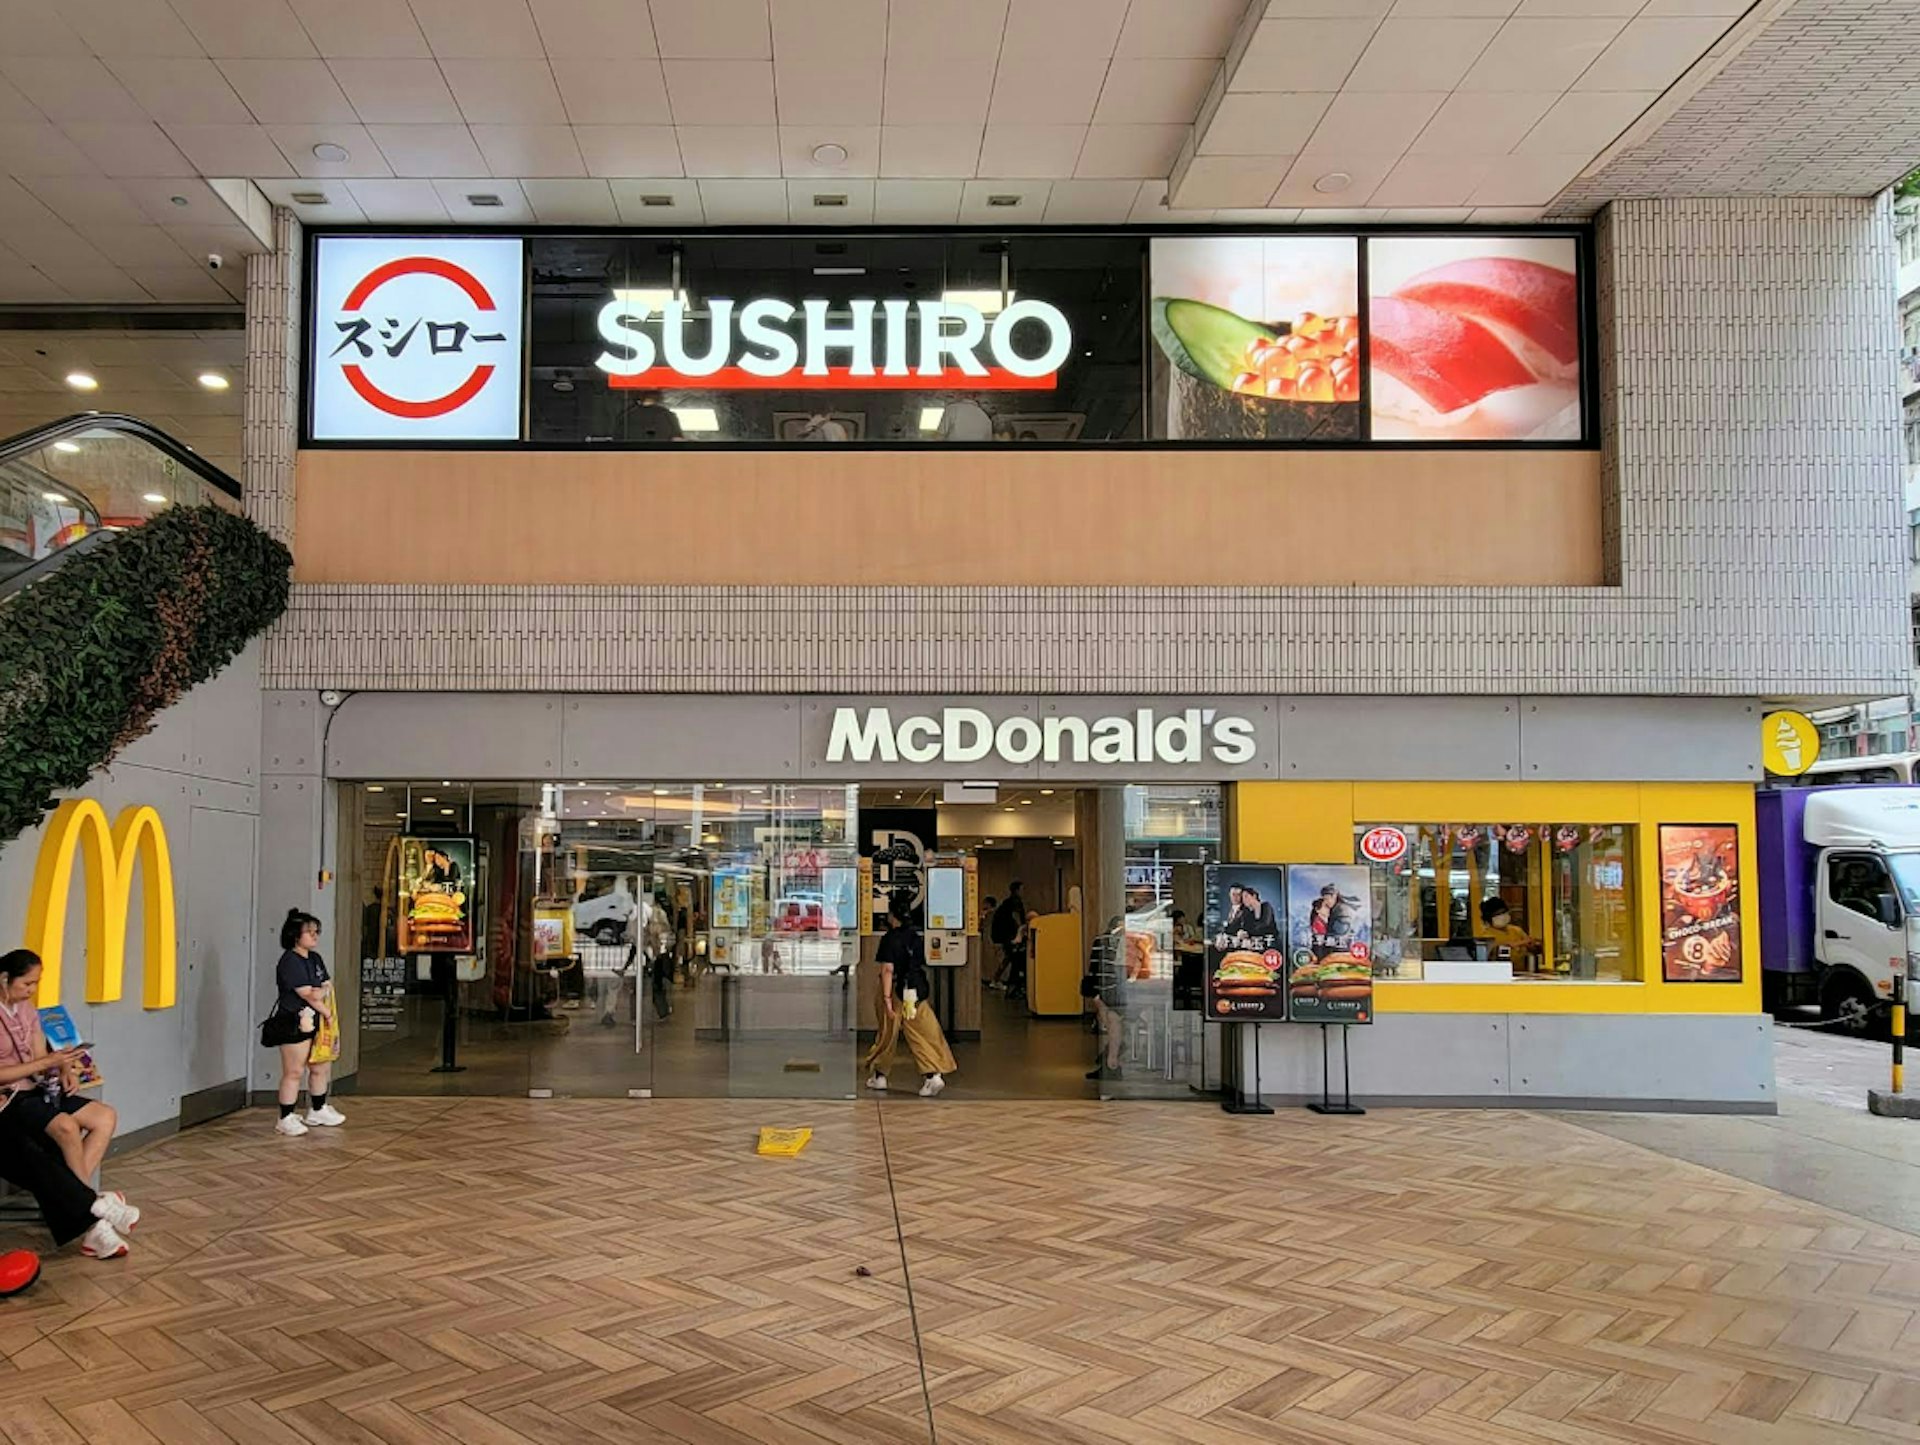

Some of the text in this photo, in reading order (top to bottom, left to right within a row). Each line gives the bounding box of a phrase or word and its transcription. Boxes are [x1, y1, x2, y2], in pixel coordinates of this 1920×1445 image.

[329, 315, 508, 359] スシロー
[594, 298, 1073, 378] SUSHIRO
[825, 706, 1257, 764] McDonald's
[1668, 915, 1734, 939] CHOCO-BREAK
